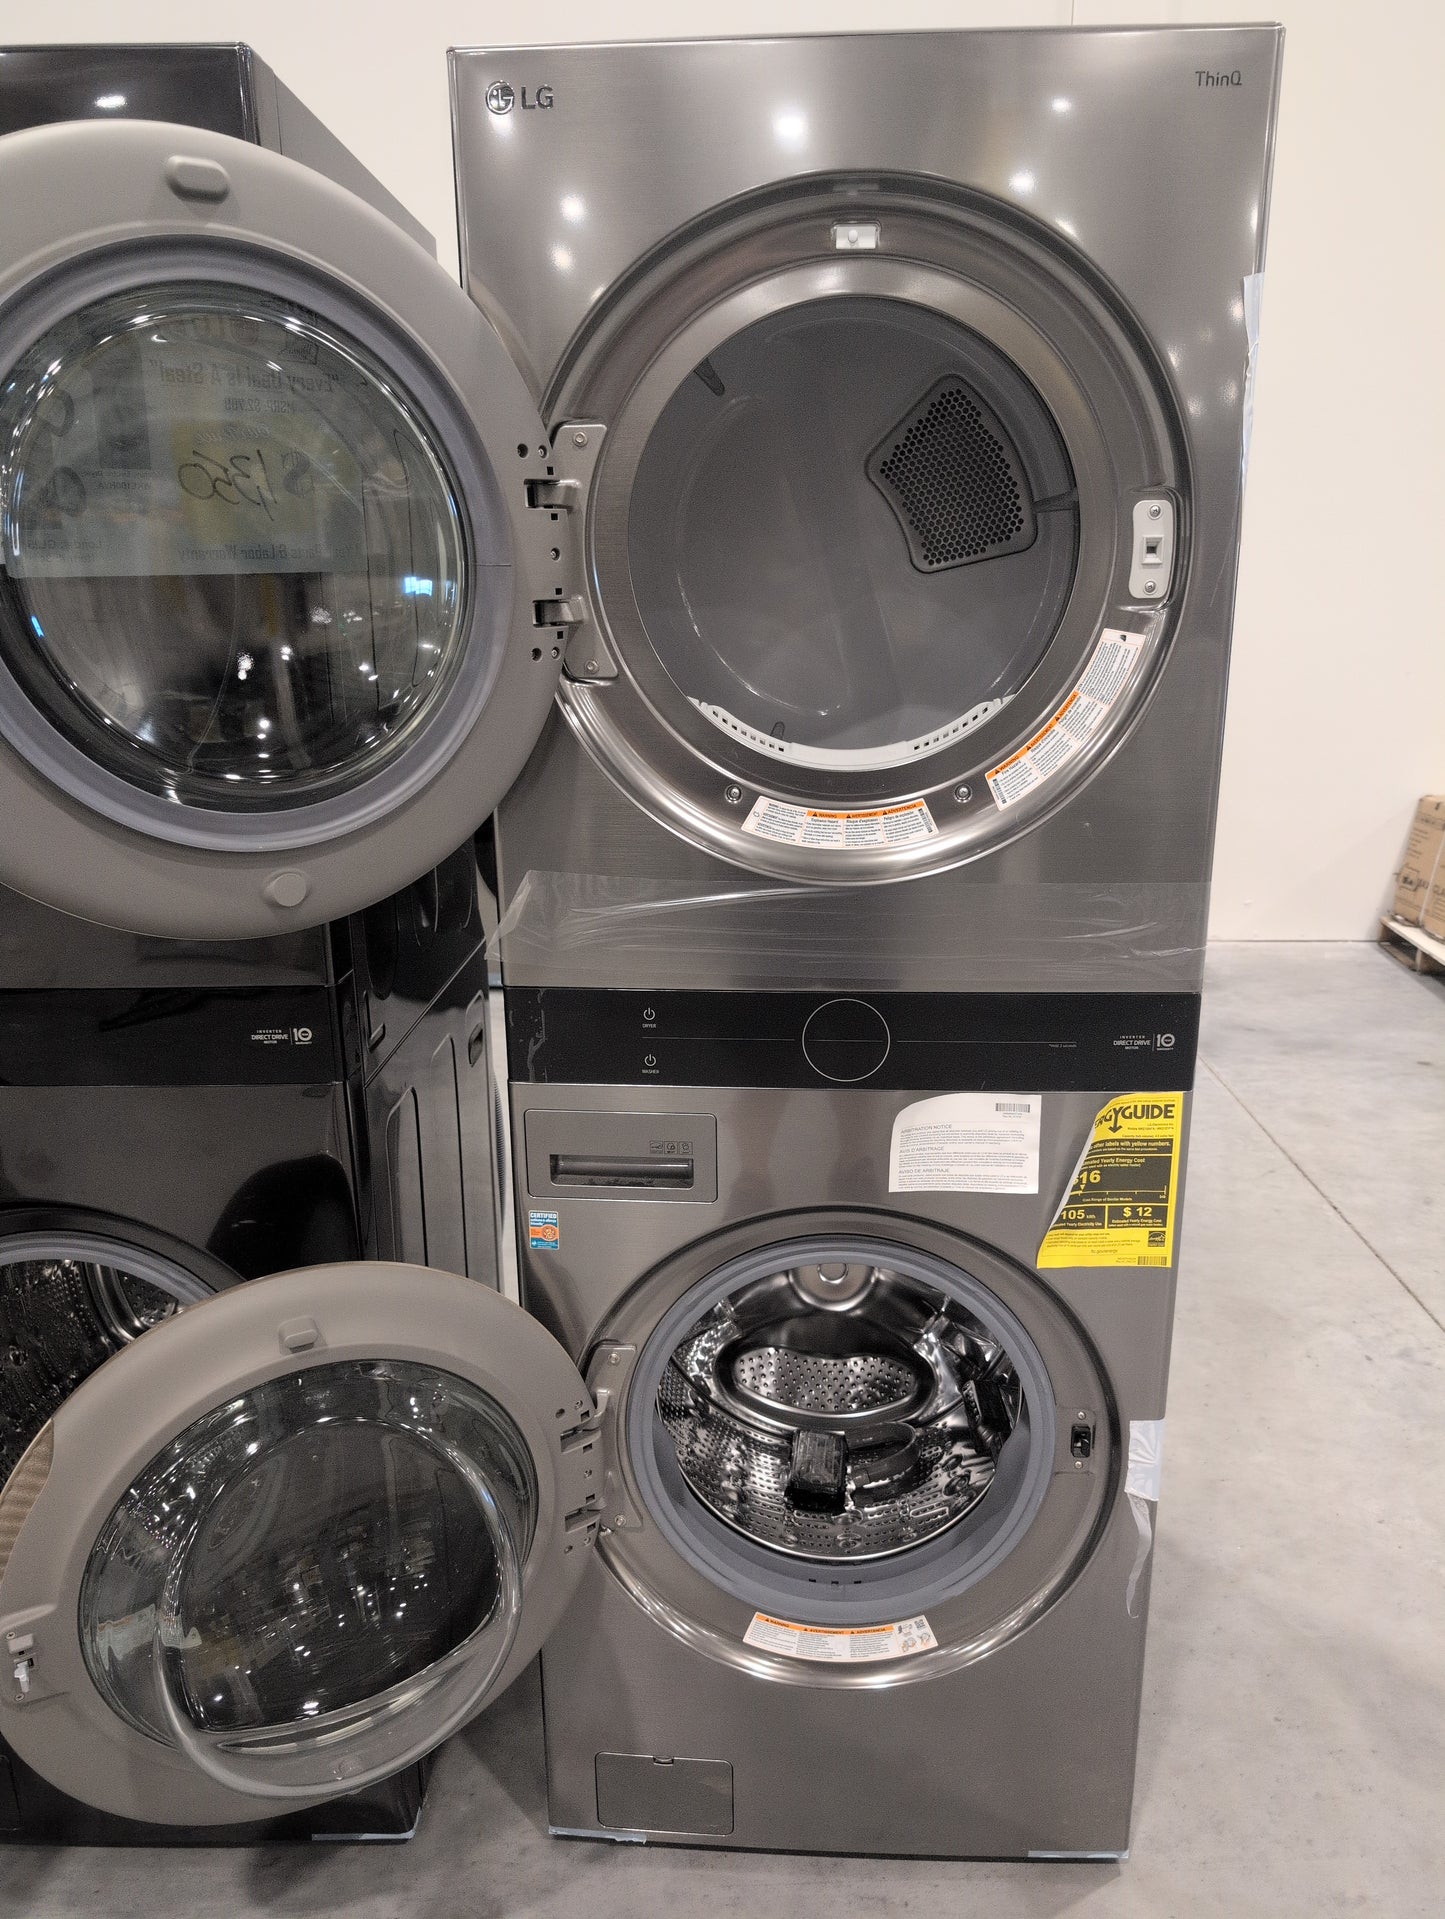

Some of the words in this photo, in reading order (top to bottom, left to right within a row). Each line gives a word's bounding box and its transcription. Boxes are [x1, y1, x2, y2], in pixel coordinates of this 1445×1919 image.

[1195, 70, 1242, 86] ThinQ
[521, 85, 554, 109] LG
[1061, 1210, 1086, 1220] 105
[1123, 1206, 1132, 1218] $
[1137, 1207, 1152, 1217] 12
[770, 1620, 790, 1628] WARNING
